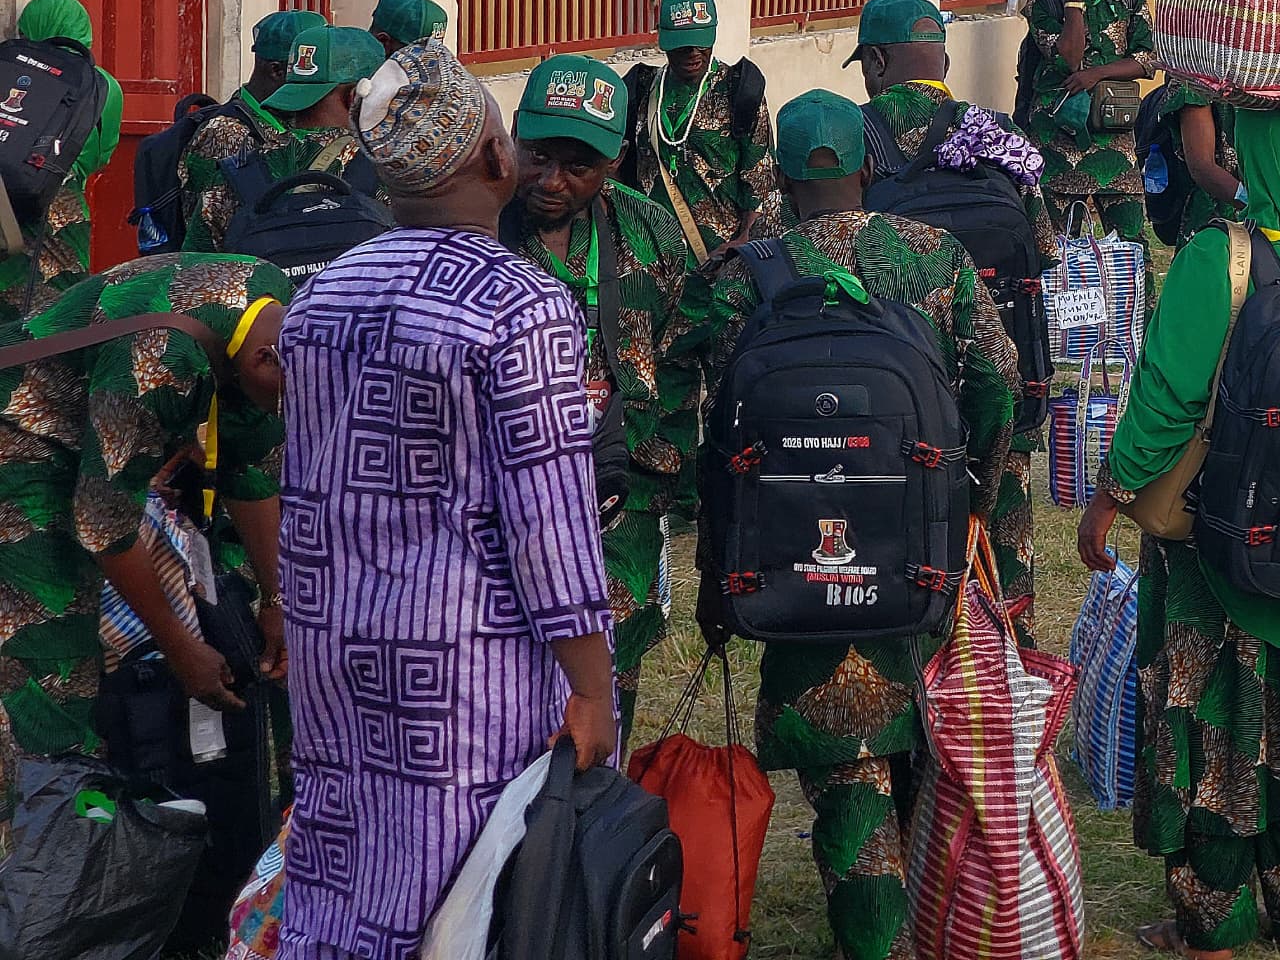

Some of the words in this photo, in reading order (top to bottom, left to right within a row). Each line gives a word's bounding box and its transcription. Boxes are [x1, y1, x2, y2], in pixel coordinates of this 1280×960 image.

[547, 83, 585, 97] 2026
[291, 266, 306, 276] OYO
[782, 437, 802, 449] 2026
[803, 438, 820, 449] OYO
[821, 437, 841, 449] HAJJ
